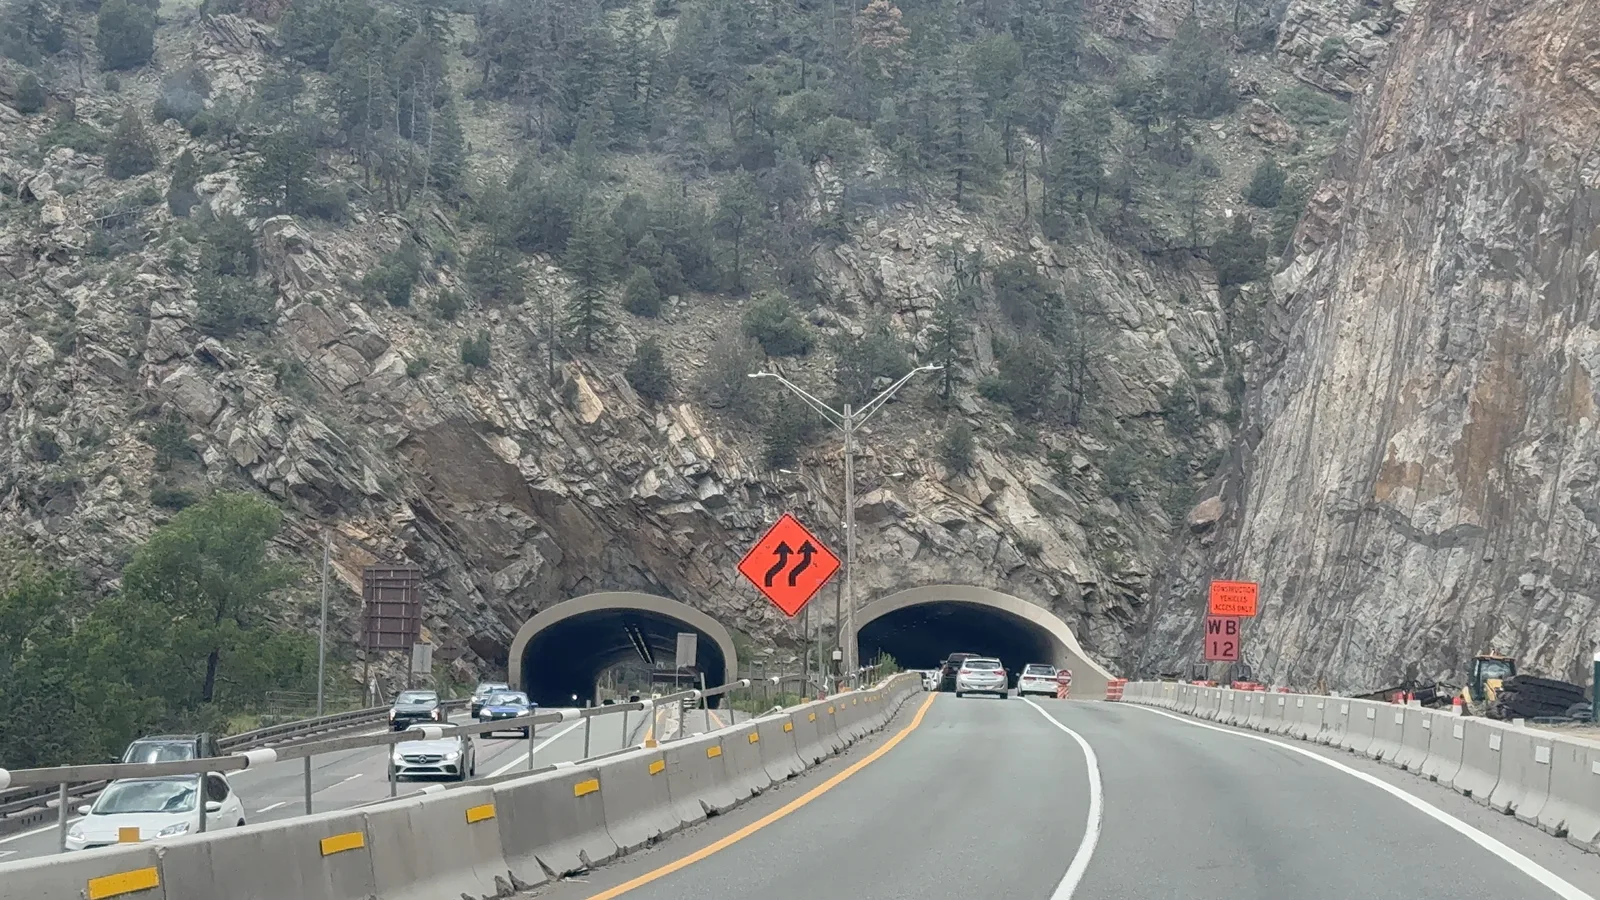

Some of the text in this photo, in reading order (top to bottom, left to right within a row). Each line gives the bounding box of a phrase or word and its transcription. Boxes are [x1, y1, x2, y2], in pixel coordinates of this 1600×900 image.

[1213, 585, 1255, 594] CONSTRUCTION
[1213, 603, 1253, 613] ACCESS ONLY
[1213, 641, 1234, 657] 12
